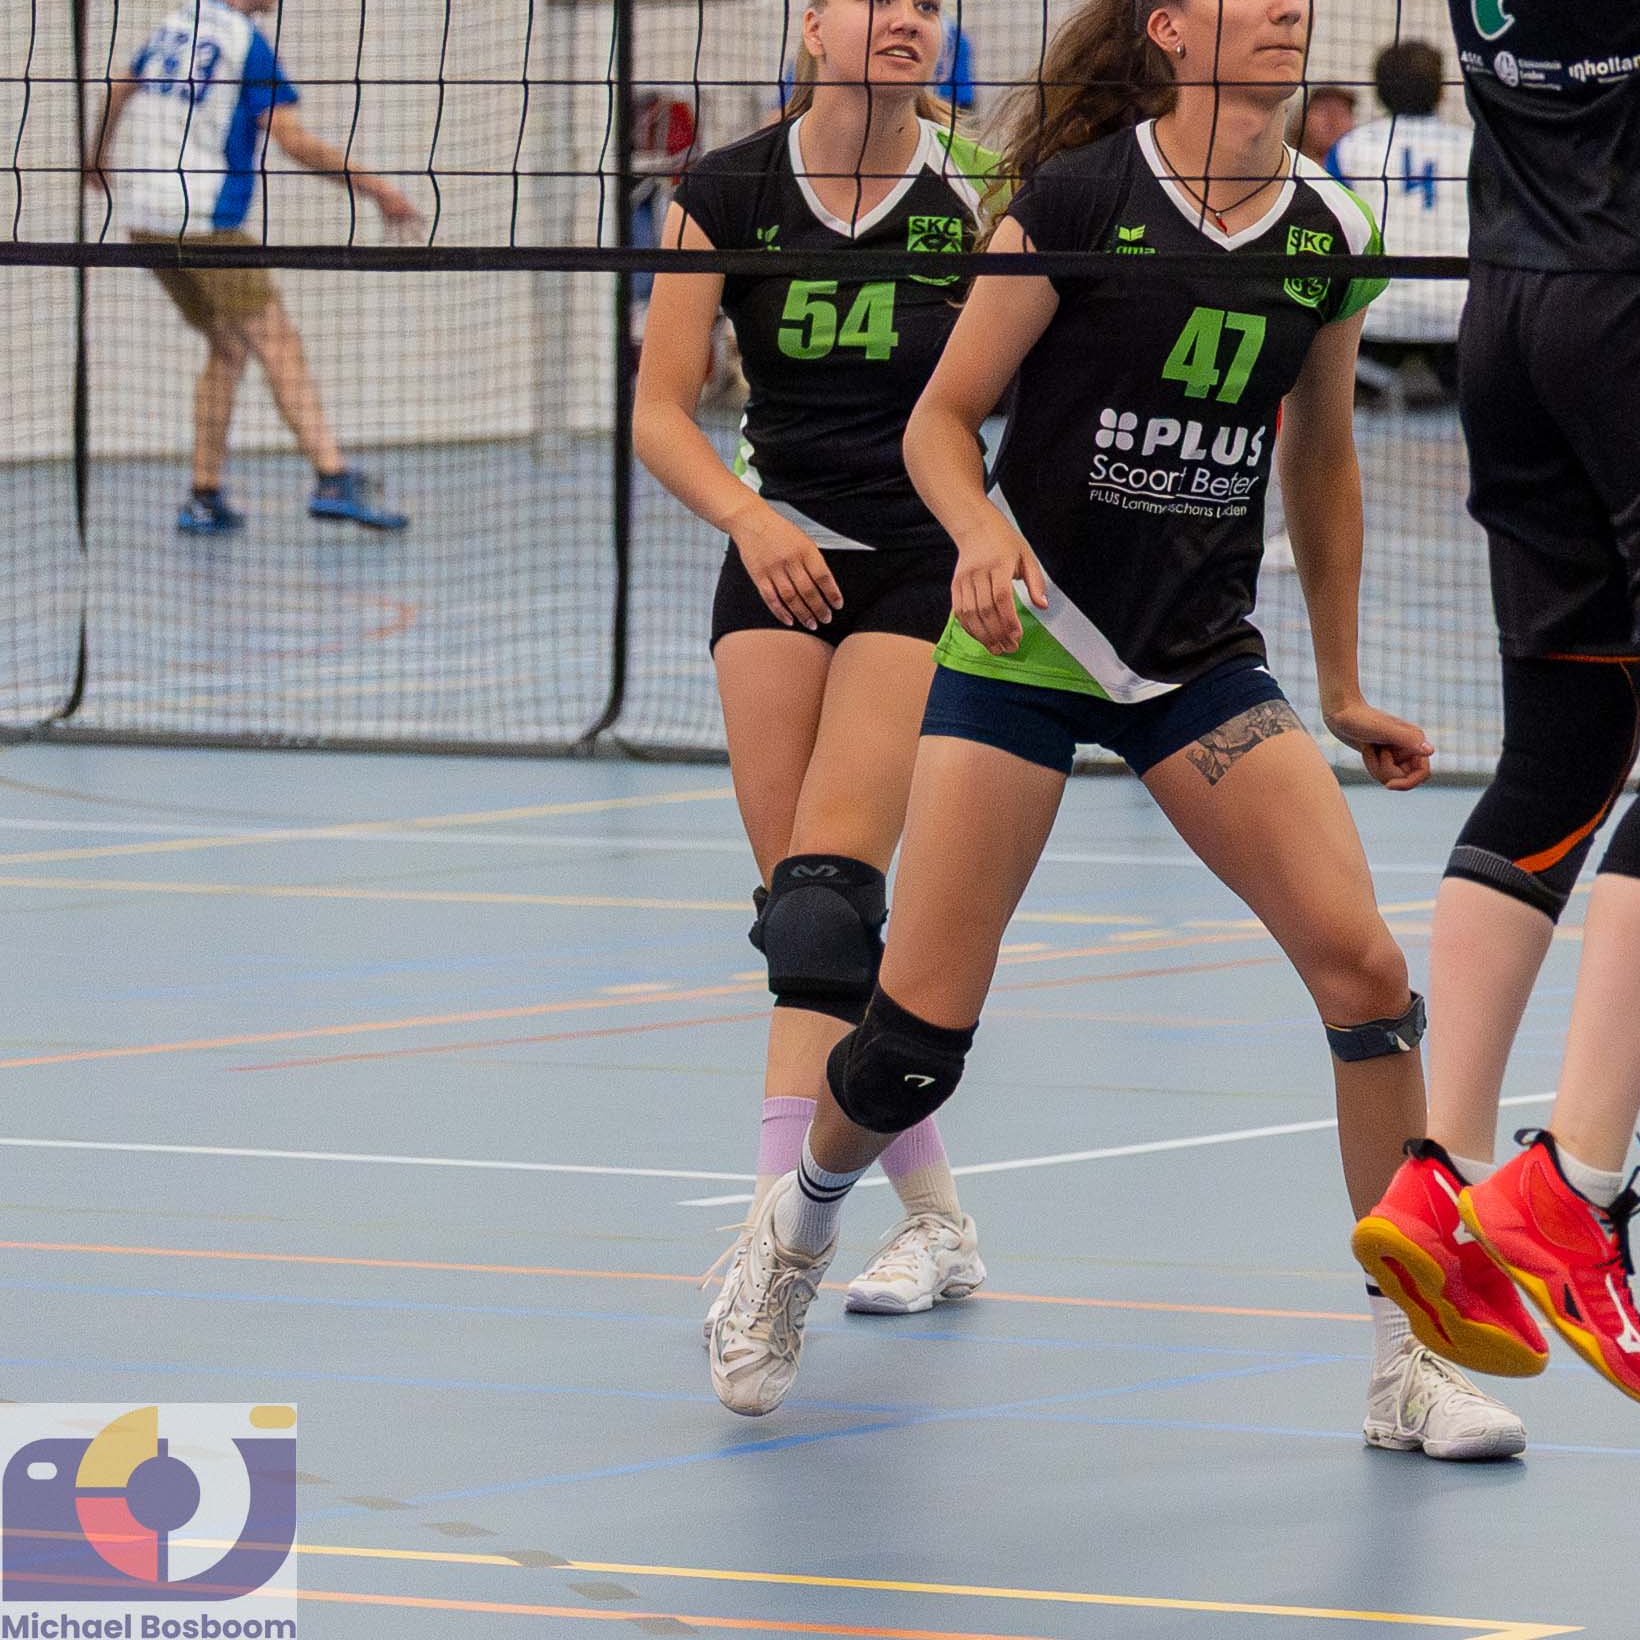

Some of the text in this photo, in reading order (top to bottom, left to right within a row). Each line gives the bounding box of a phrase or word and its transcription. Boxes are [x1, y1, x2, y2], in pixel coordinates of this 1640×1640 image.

[911, 218, 959, 237] SKC
[1290, 229, 1332, 253] SKC
[777, 279, 899, 360] 54
[1161, 306, 1267, 405] 47
[1141, 417, 1266, 467] PLUS
[1190, 468, 1260, 494] Beter
[1089, 490, 1119, 506] PLUS
[1216, 504, 1247, 519] Lden
